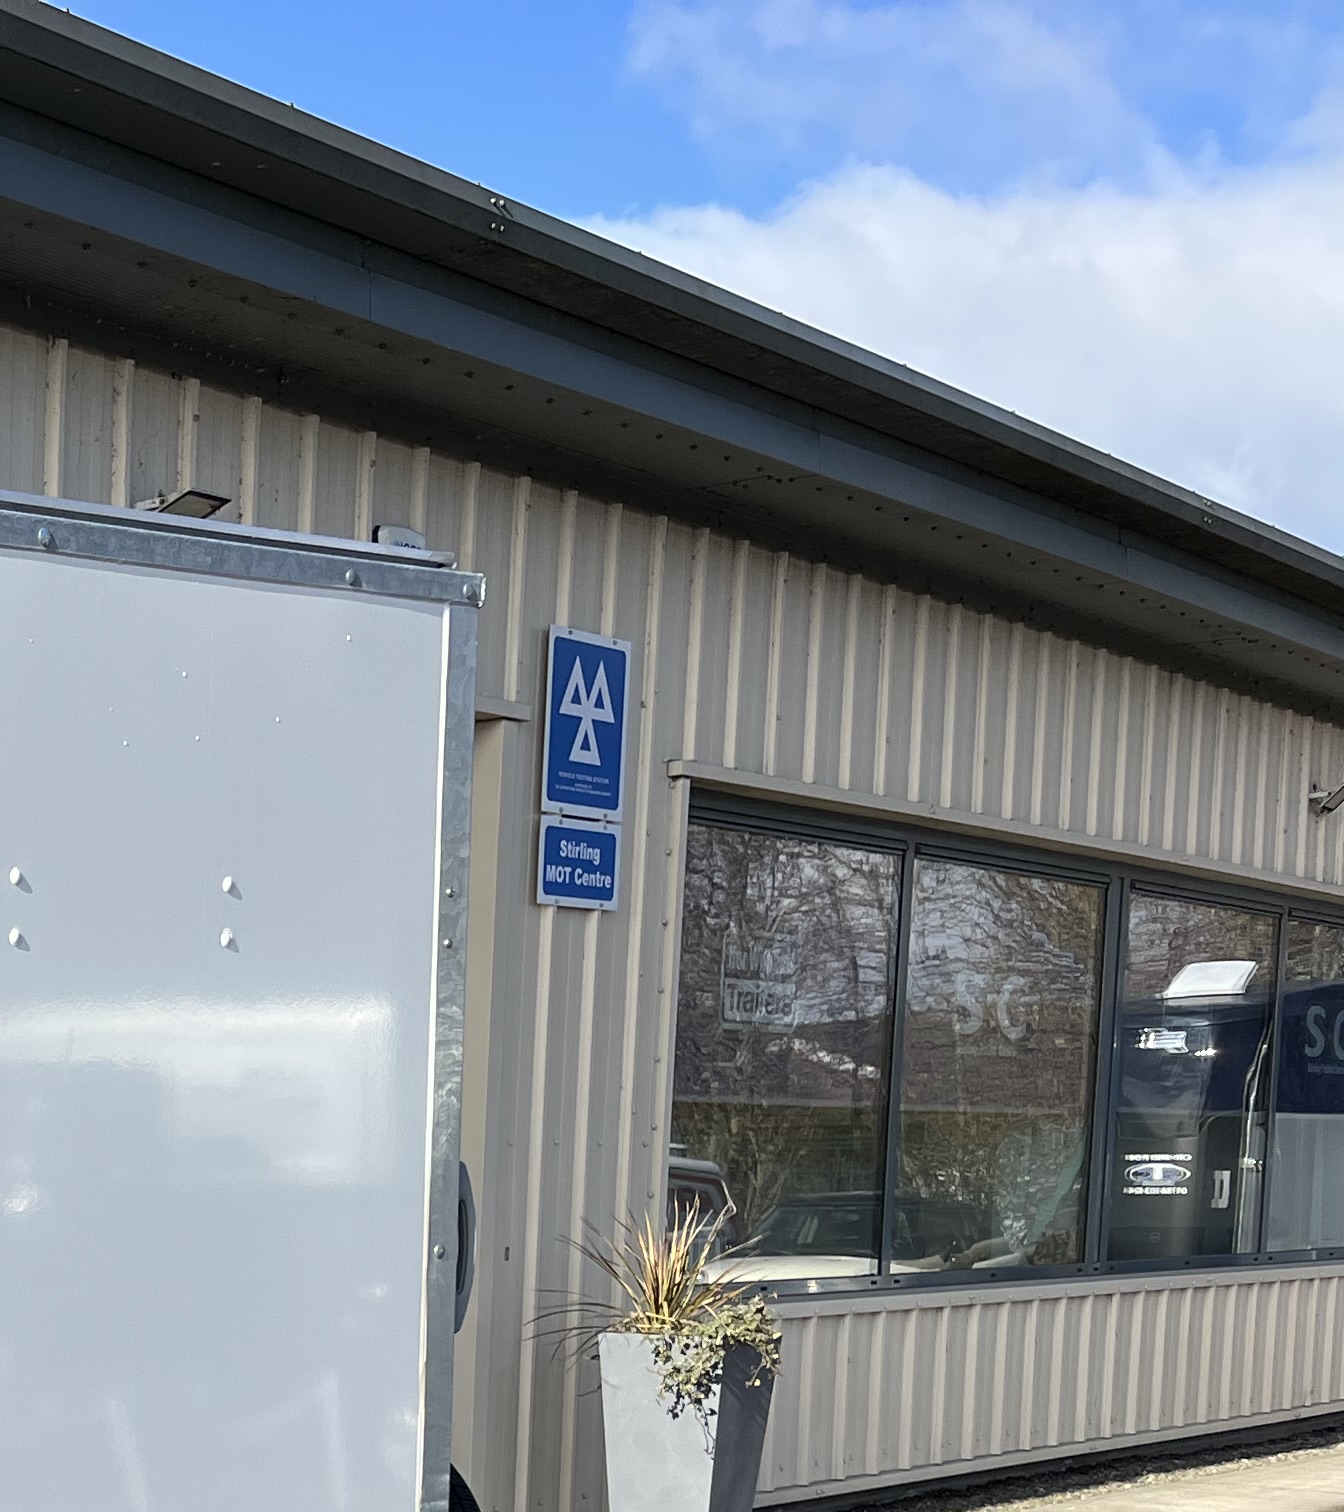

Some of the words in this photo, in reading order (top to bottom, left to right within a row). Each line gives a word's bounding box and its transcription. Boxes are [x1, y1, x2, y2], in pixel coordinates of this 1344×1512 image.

[559, 839, 601, 866] Stirling
[545, 864, 572, 884] MOT
[574, 867, 612, 889] Centre
